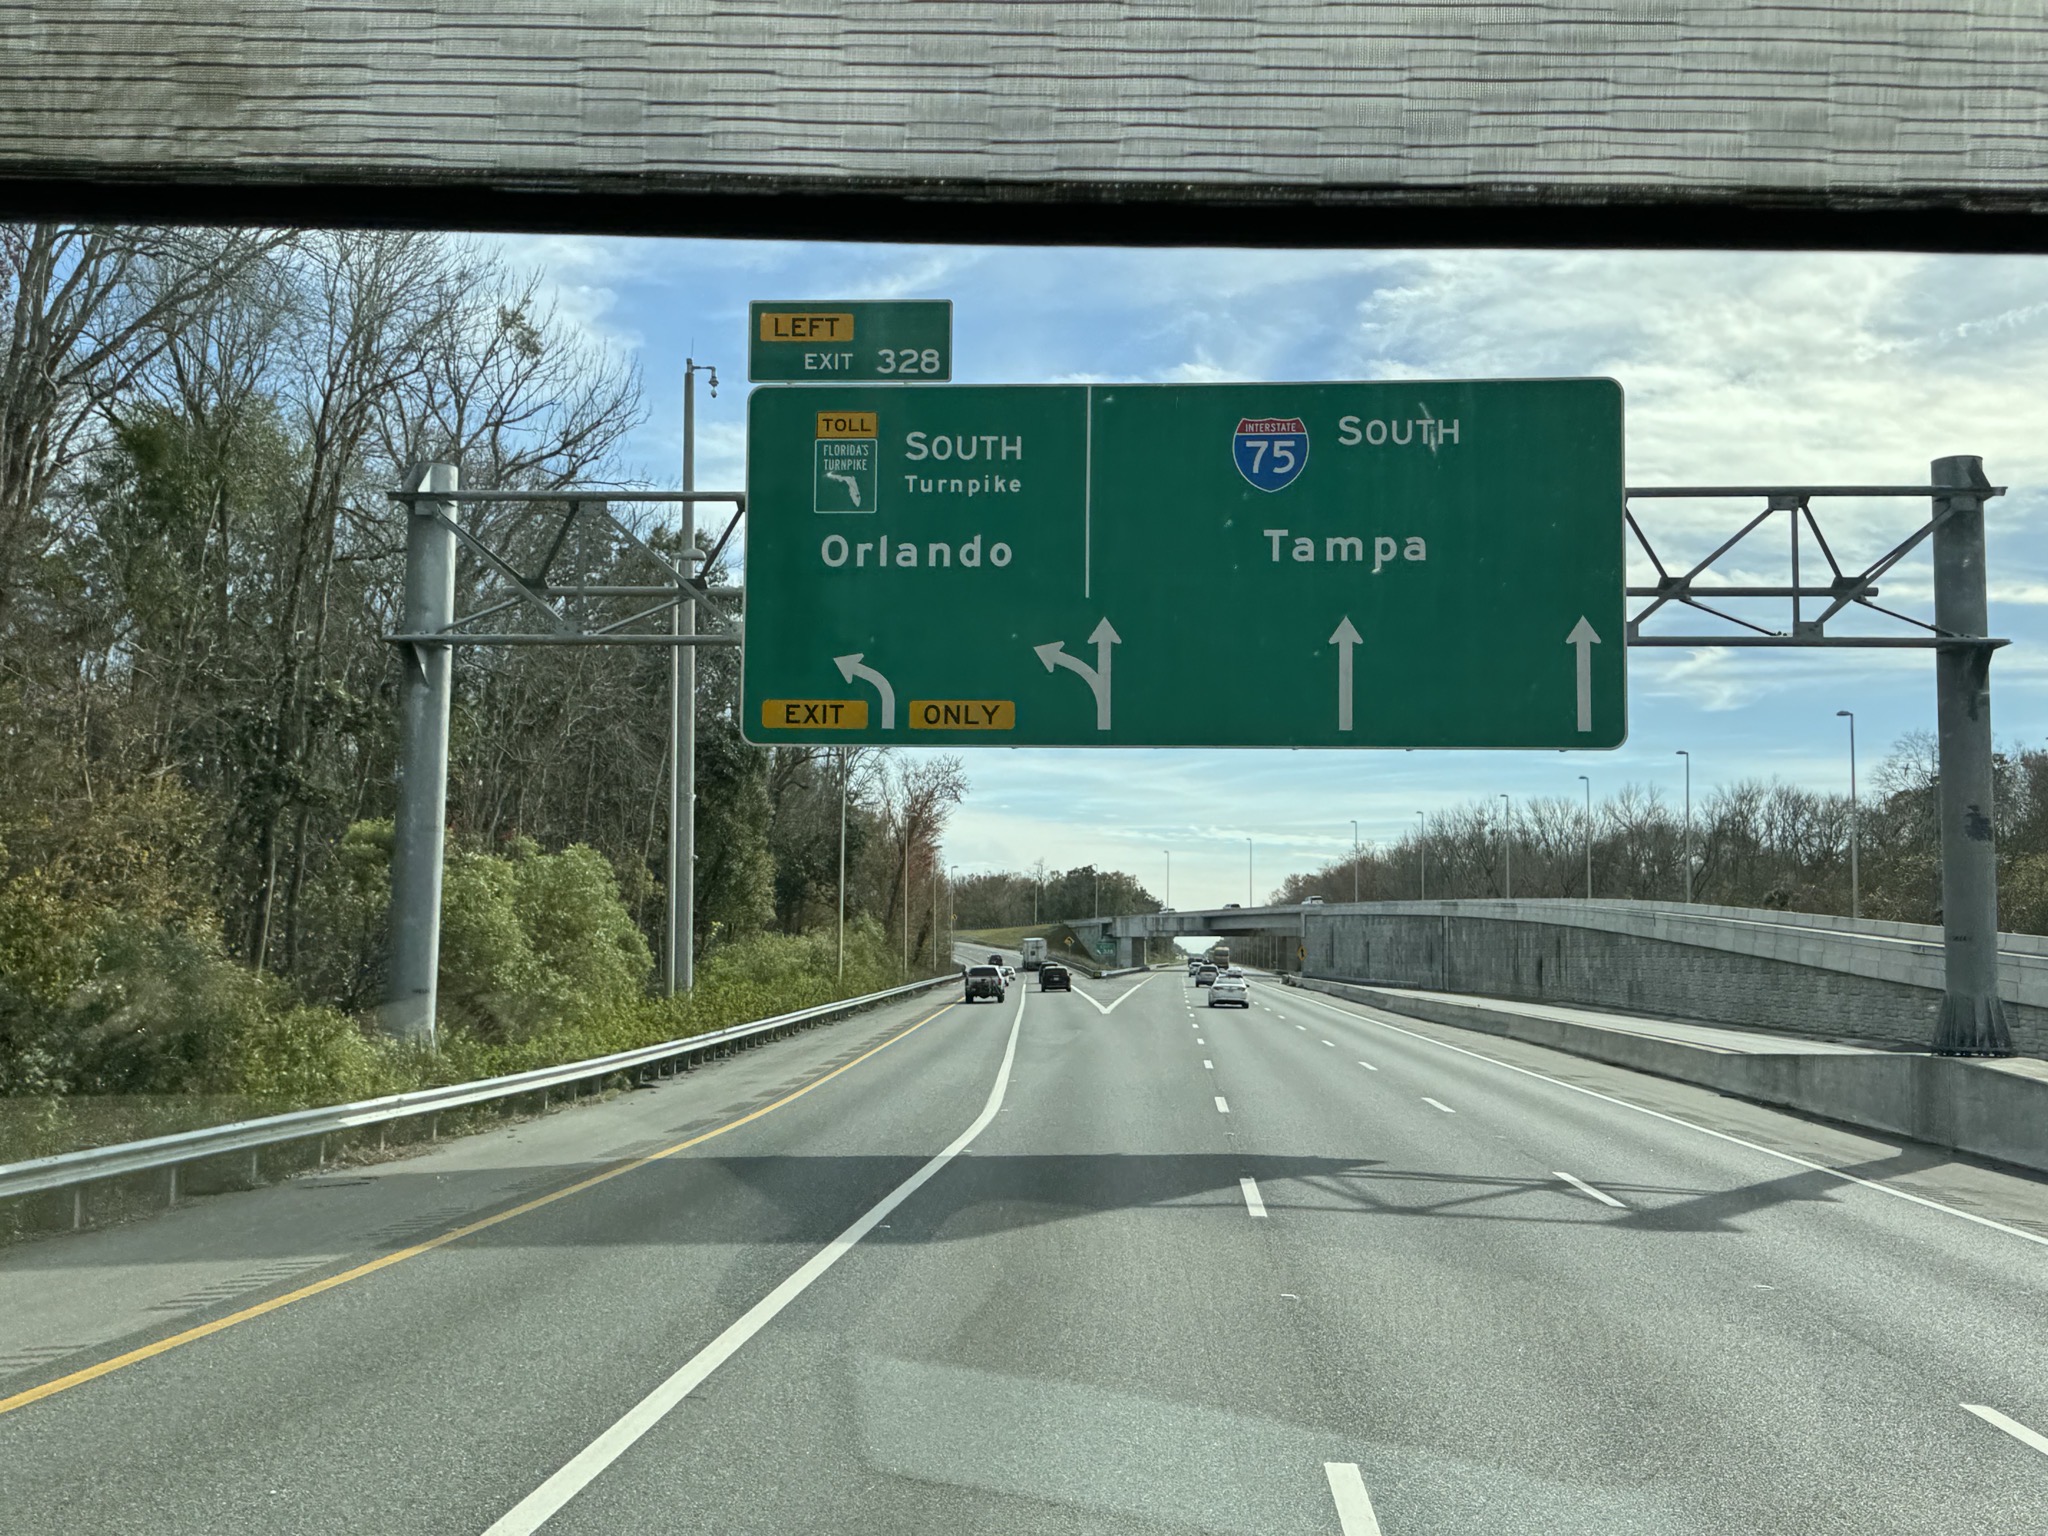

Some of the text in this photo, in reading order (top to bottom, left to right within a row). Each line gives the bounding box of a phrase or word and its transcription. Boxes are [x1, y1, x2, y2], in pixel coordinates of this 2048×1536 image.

[774, 317, 840, 337] LEFT
[804, 349, 940, 374] EXIT 328
[822, 418, 872, 432] TOLL
[1245, 422, 1297, 433] INTERSTATE
[1338, 415, 1460, 446] SOUTH
[823, 444, 869, 457] FLORIDA'S
[904, 431, 1022, 461] SOUTH
[1245, 440, 1296, 474] 75
[823, 459, 868, 471] TURNPIKE
[904, 474, 1022, 497] Turnpike
[821, 534, 1013, 567] Orlando
[1263, 529, 1427, 574] Tampa
[785, 704, 1000, 725] EXIT ONLY
